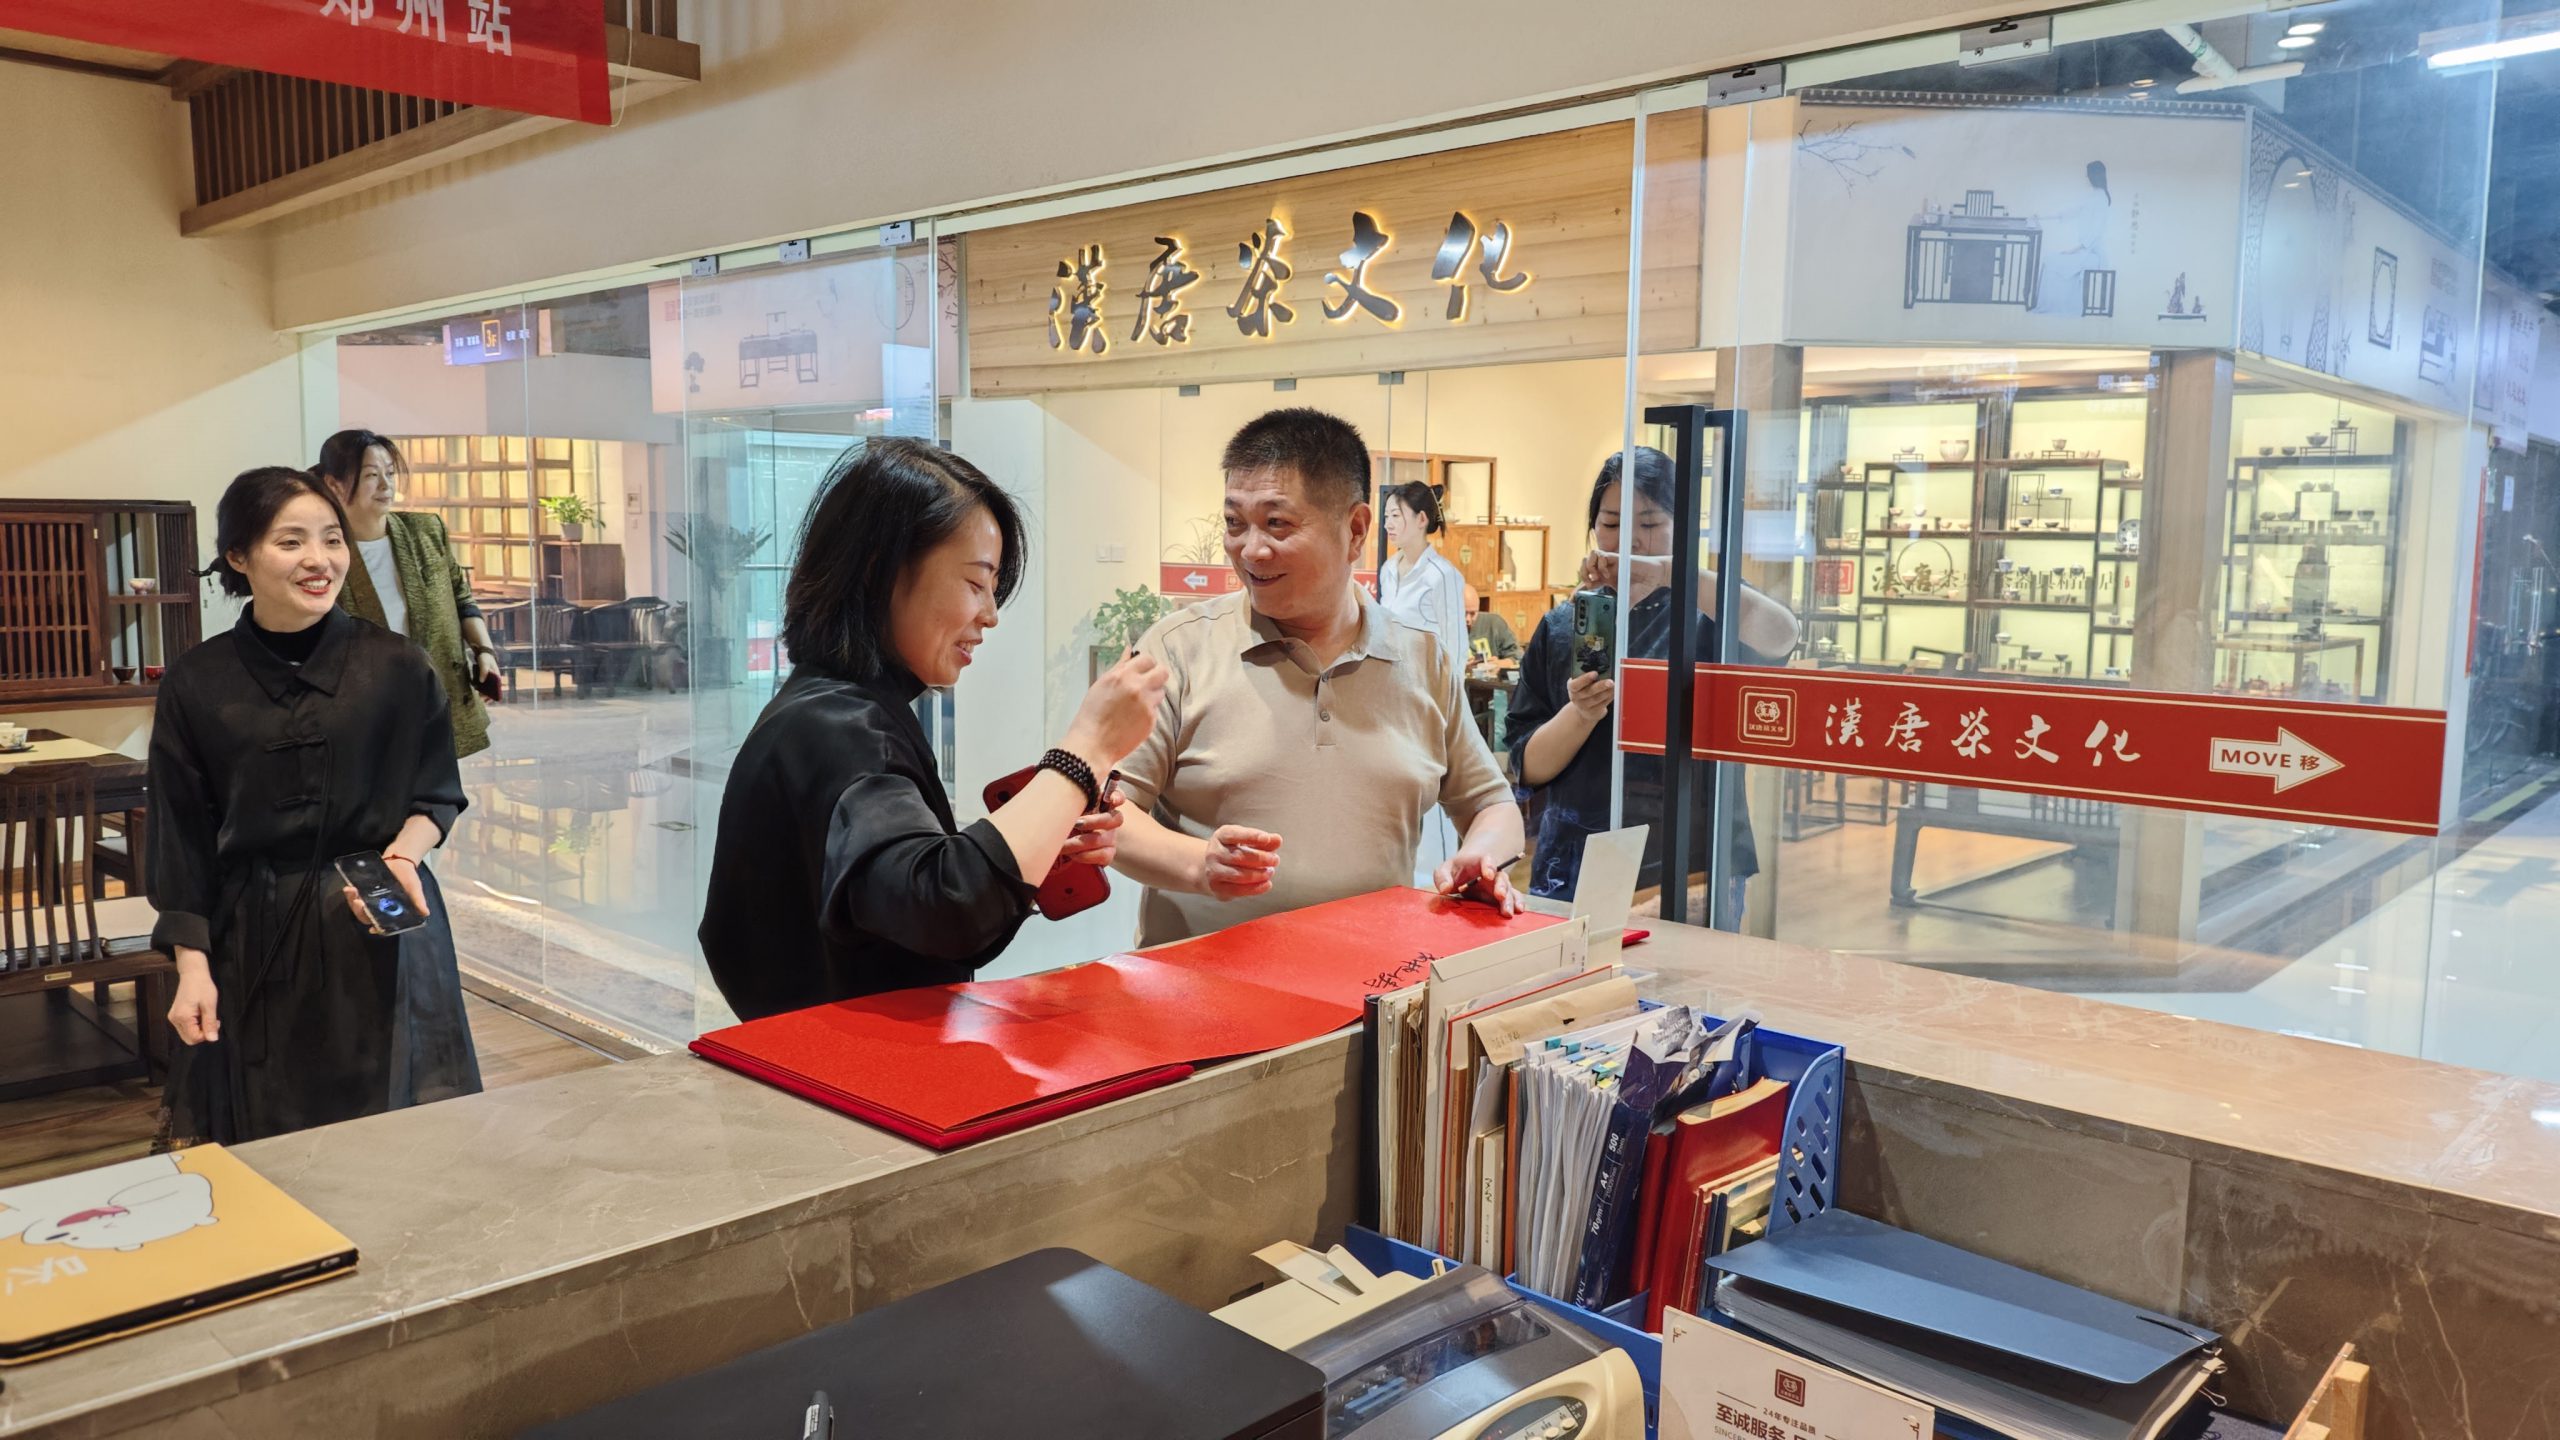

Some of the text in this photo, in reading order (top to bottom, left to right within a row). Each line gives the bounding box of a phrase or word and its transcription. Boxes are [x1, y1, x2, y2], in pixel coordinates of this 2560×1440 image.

[1049, 211, 1530, 353] 漢唐茶文化
[1825, 697, 2141, 767] 漢唐茶文化
[2221, 748, 2320, 771] MOVE 移
[1609, 1132, 1619, 1152] 500
[1600, 1171, 1609, 1190] A4
[1716, 1402, 1786, 1440] 至诚服务
